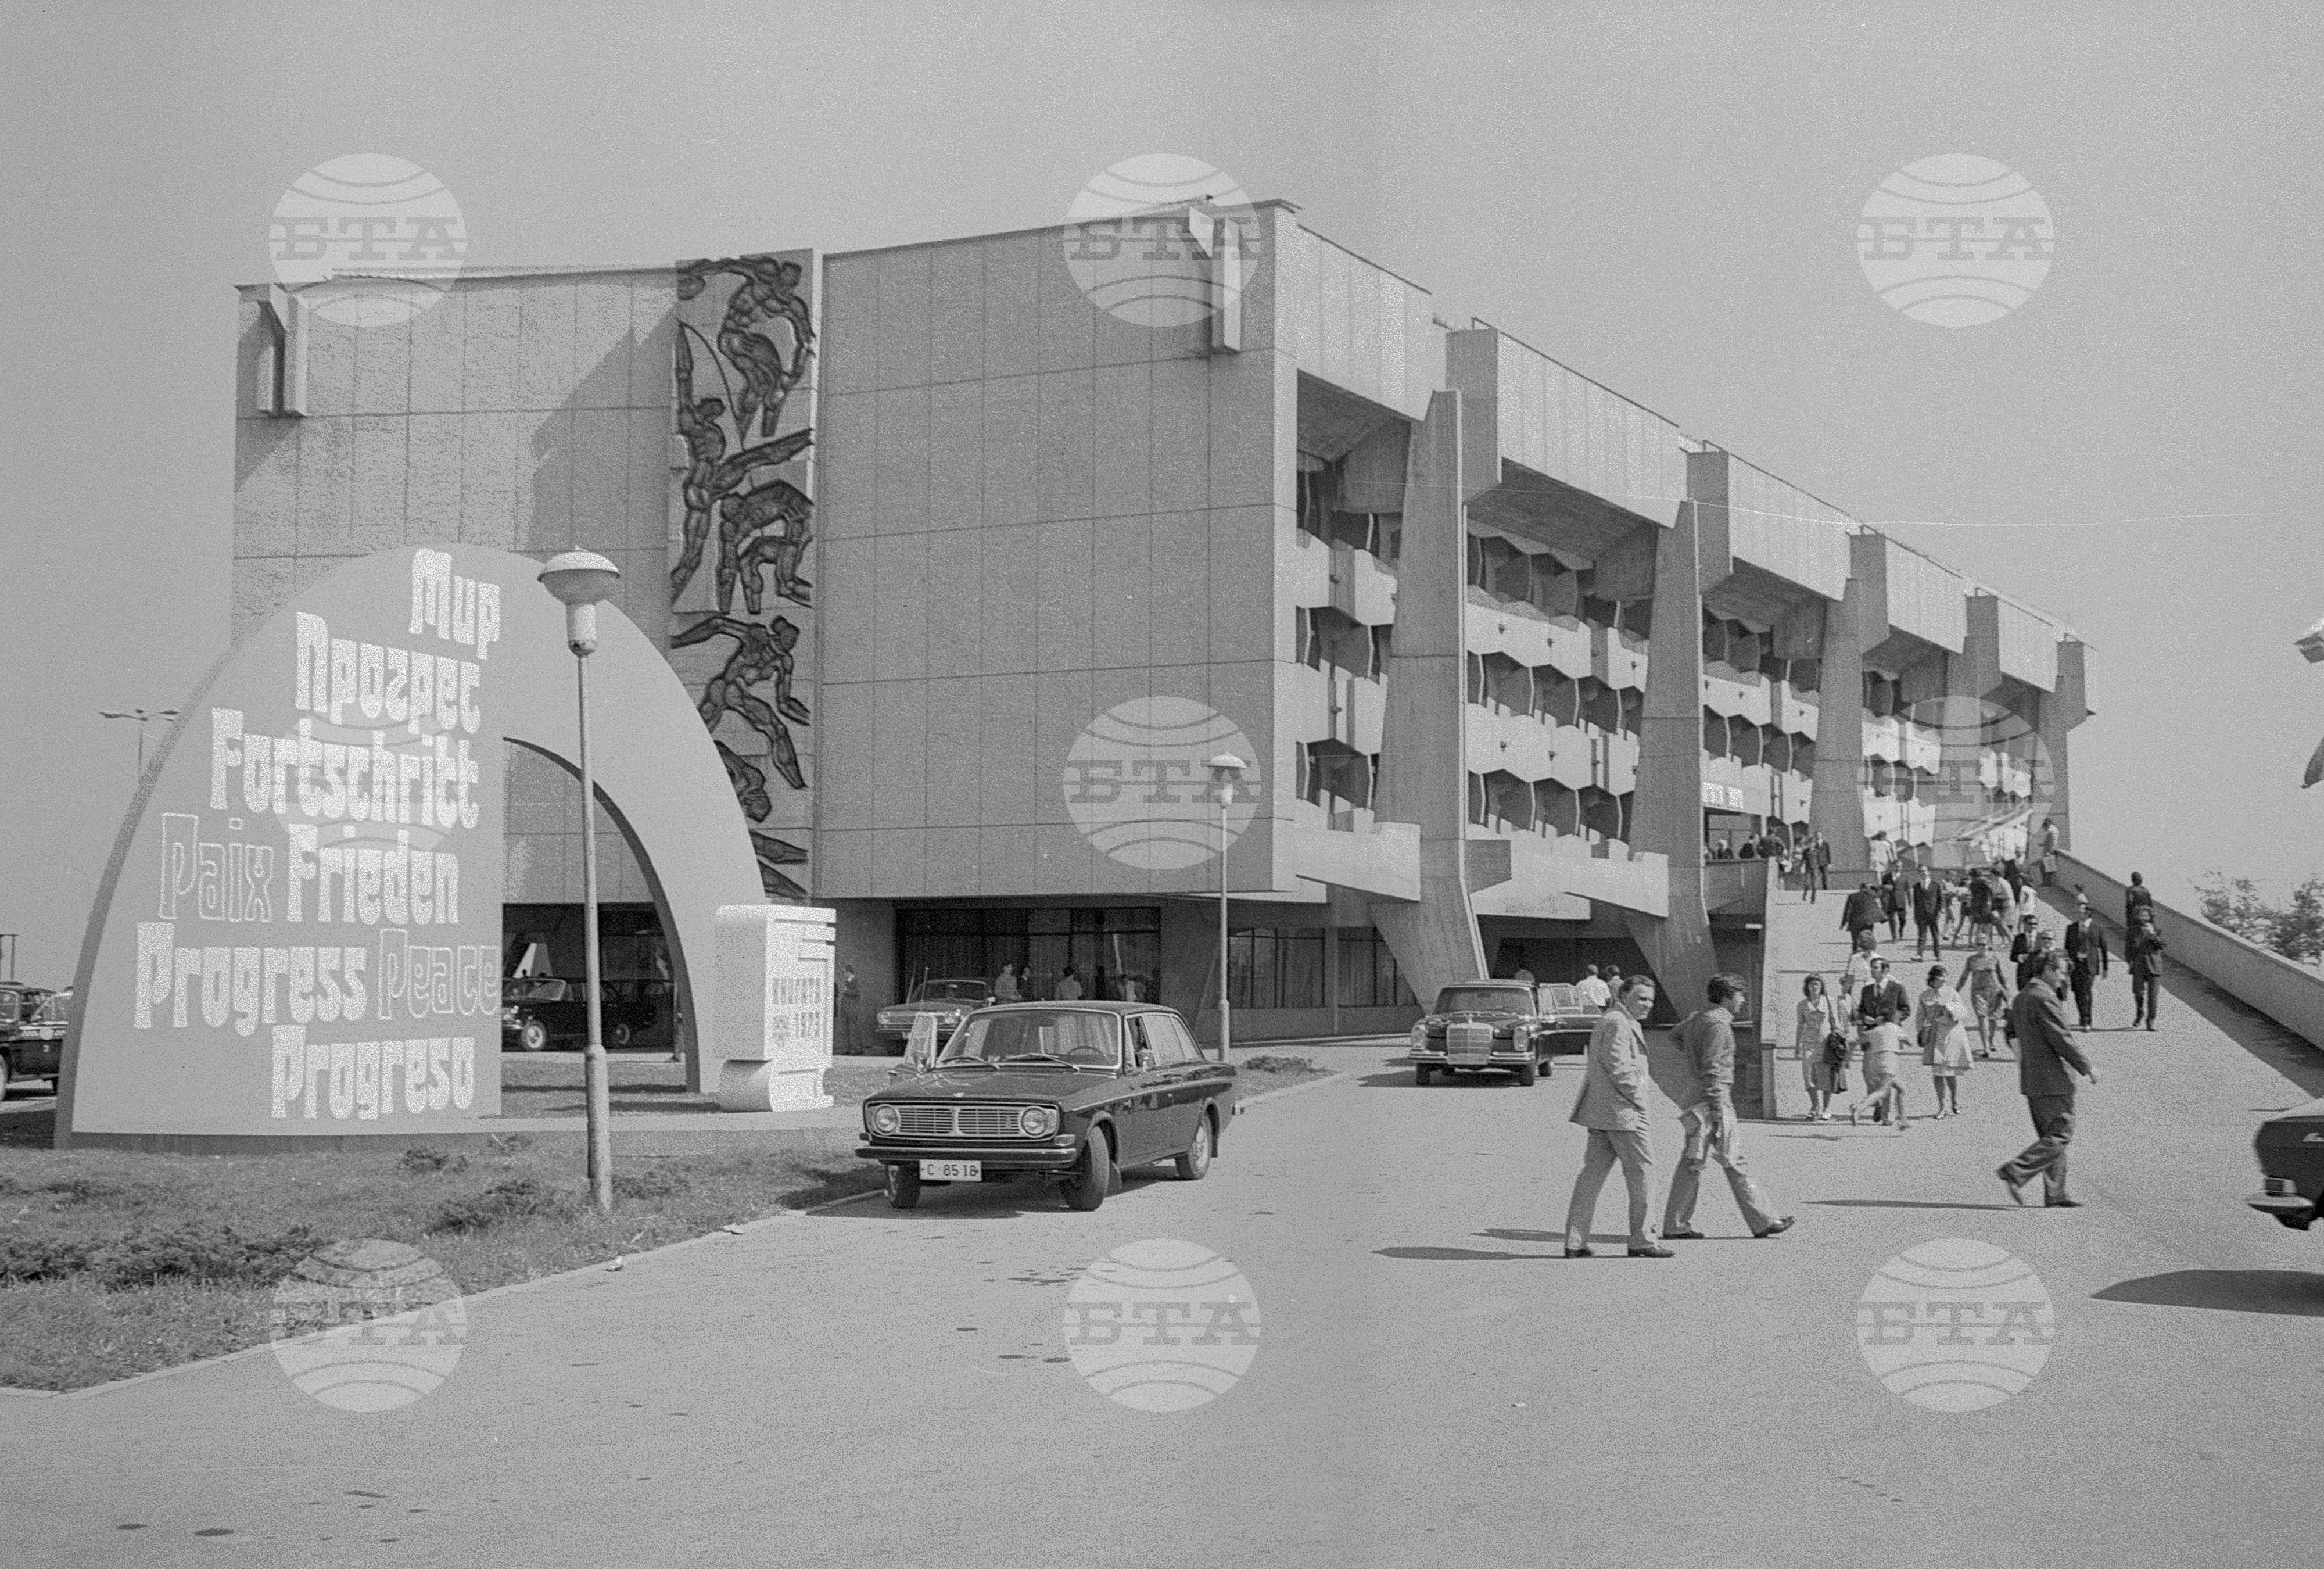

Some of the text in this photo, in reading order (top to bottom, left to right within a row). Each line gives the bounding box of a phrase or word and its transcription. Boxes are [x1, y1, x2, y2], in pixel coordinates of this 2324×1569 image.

[408, 548, 500, 660] Мир
[210, 707, 479, 829] Fortschritt
[159, 812, 459, 924] Paix Frieden
[134, 921, 499, 1037] Progress Peace
[271, 1025, 474, 1119] Progreso
